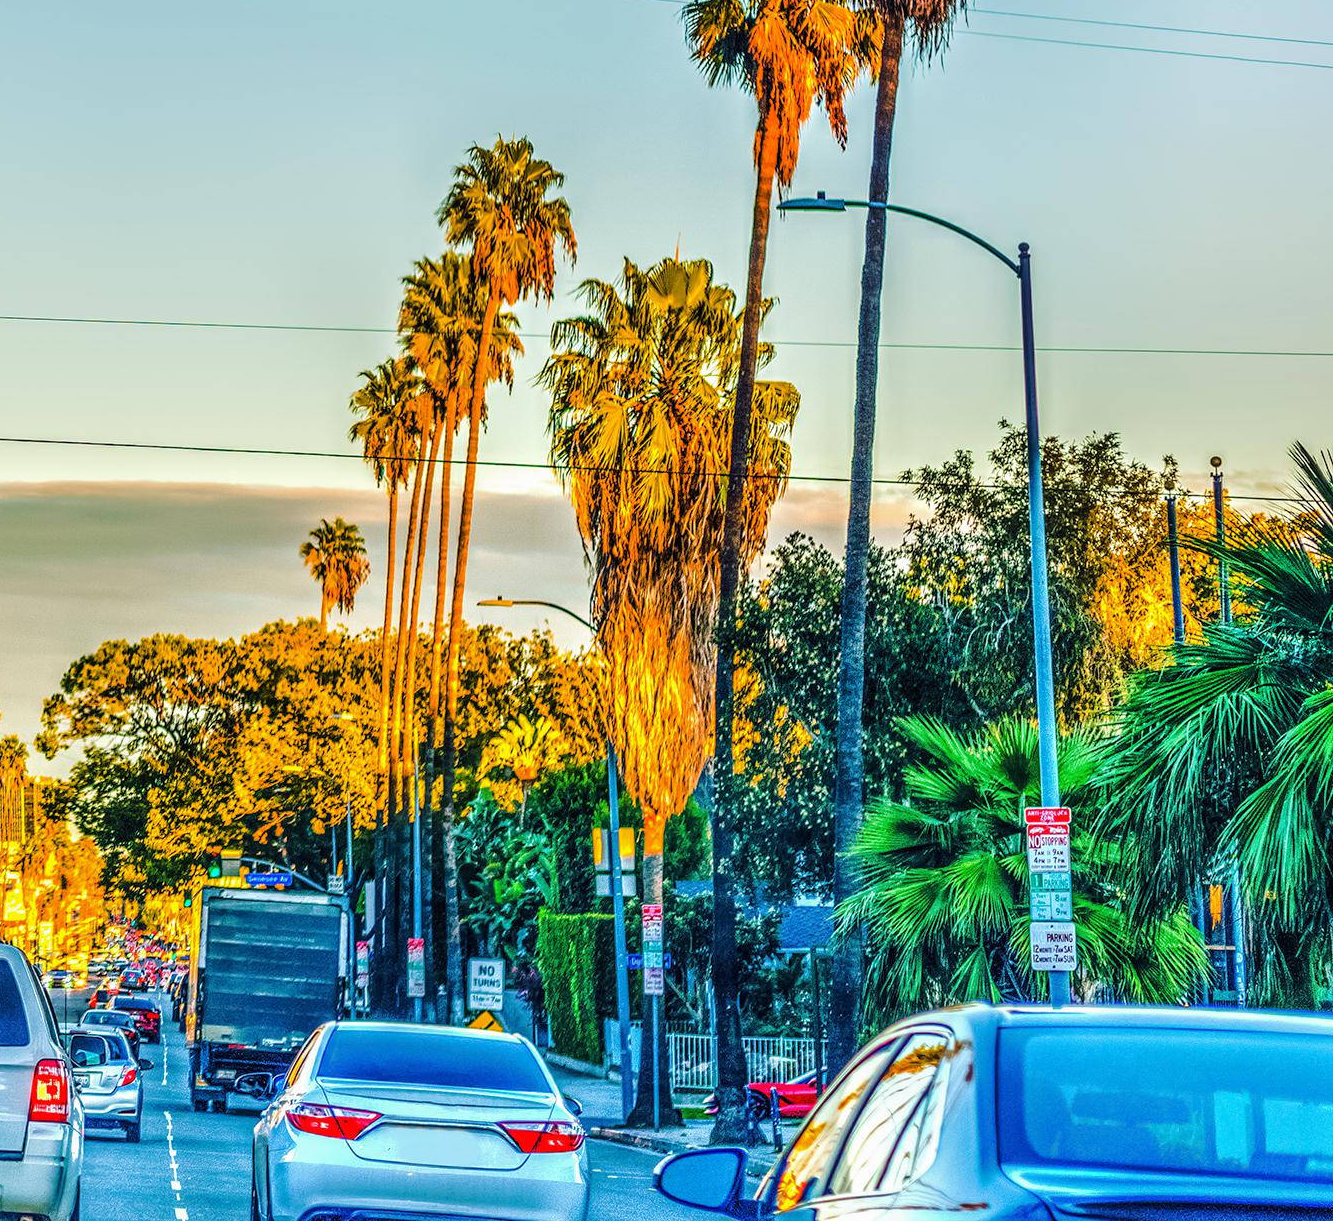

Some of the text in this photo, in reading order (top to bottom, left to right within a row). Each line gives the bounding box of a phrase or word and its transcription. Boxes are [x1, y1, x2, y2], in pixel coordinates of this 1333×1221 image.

[1029, 835, 1067, 847] NO STOPPING
[1044, 879, 1069, 888] PARKING
[1046, 933, 1073, 943] PARKING
[1064, 945, 1073, 954] SAT
[1064, 954, 1075, 963] SUN
[478, 965, 495, 977] NO
[473, 978, 501, 988] TURNS
